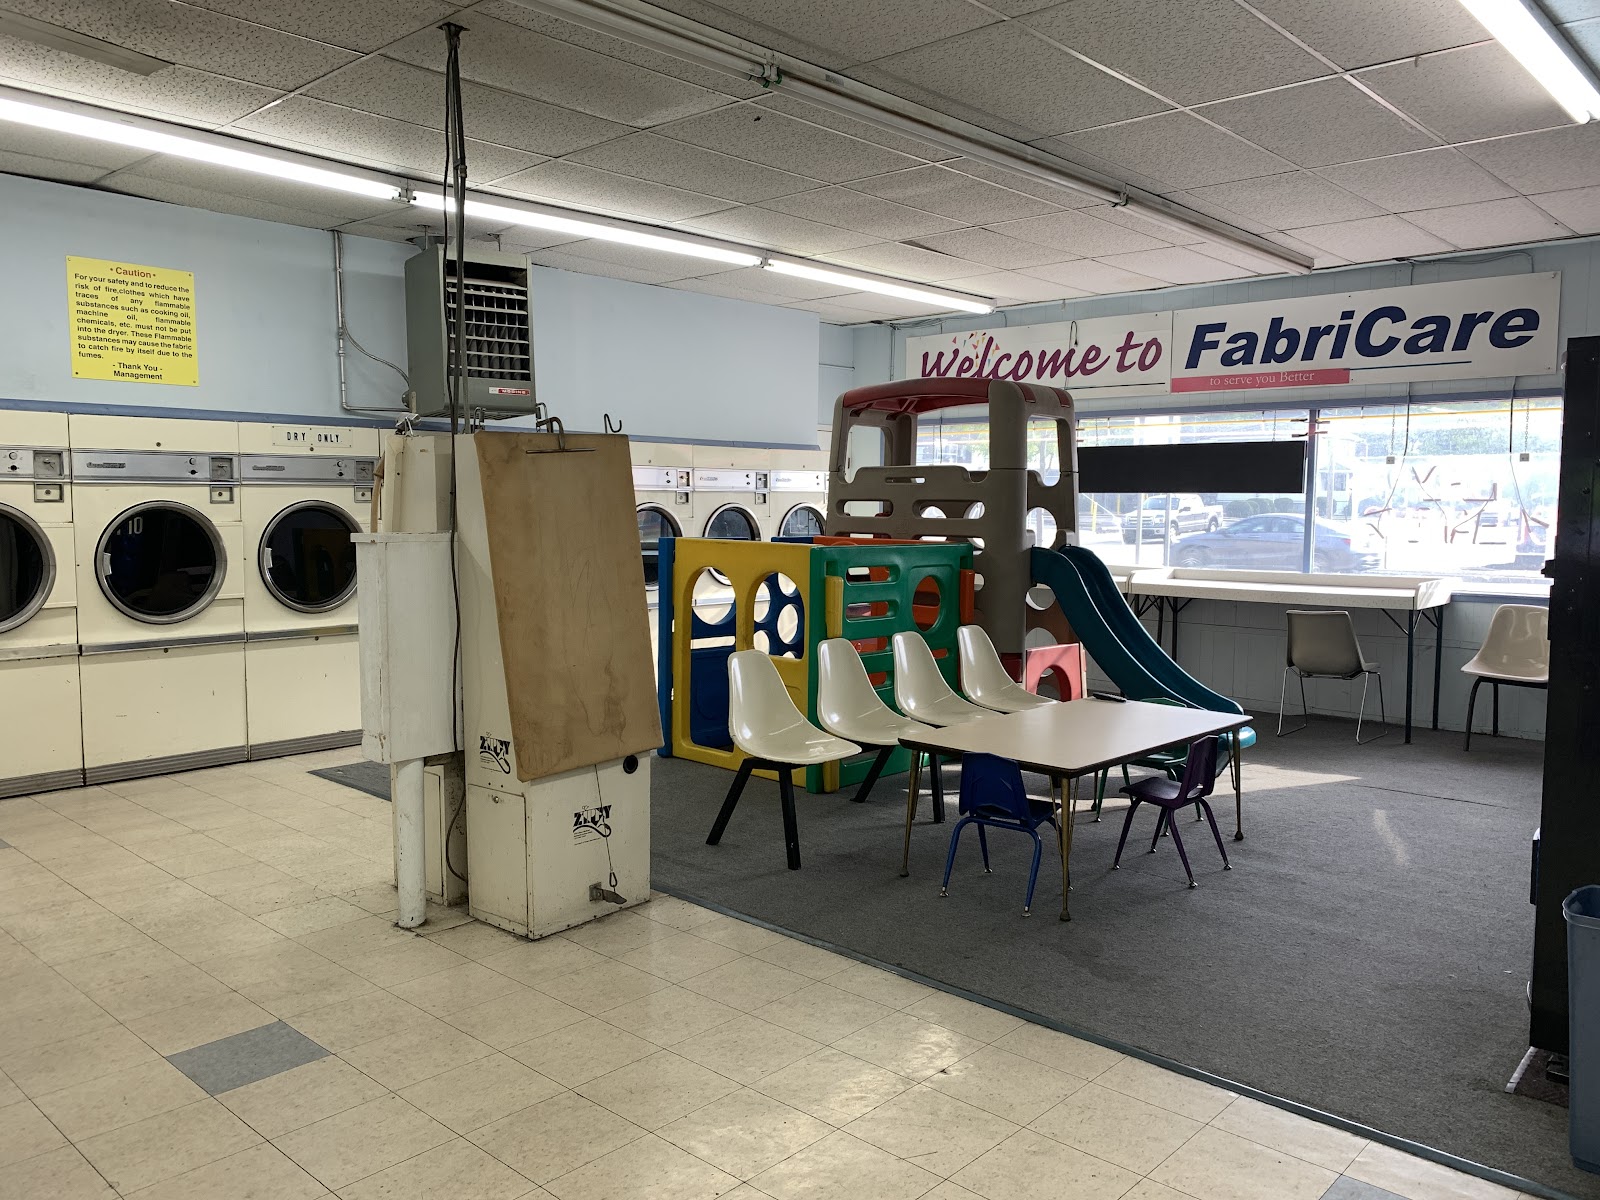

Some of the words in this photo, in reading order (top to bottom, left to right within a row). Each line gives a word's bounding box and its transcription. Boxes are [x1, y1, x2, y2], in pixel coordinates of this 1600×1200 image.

[116, 266, 152, 278] Caution
[108, 278, 130, 286] safety
[76, 292, 98, 300] traces
[154, 300, 190, 310] flammable
[76, 300, 118, 310] substances
[150, 309, 178, 318] cooking
[76, 310, 108, 318] machine
[156, 316, 191, 326] flammable
[76, 317, 117, 327] chemicals,
[78, 334, 120, 344] substances
[154, 333, 192, 342] Flammable
[1184, 306, 1541, 370] FabriCare
[78, 351, 104, 359] fumes.
[1116, 331, 1163, 373] to
[117, 362, 142, 370] Thank
[114, 370, 163, 380] Management
[1210, 377, 1220, 386] to
[1224, 376, 1252, 385] serve
[1256, 375, 1276, 387] you
[1280, 371, 1315, 382] Better
[286, 432, 306, 440] DRY
